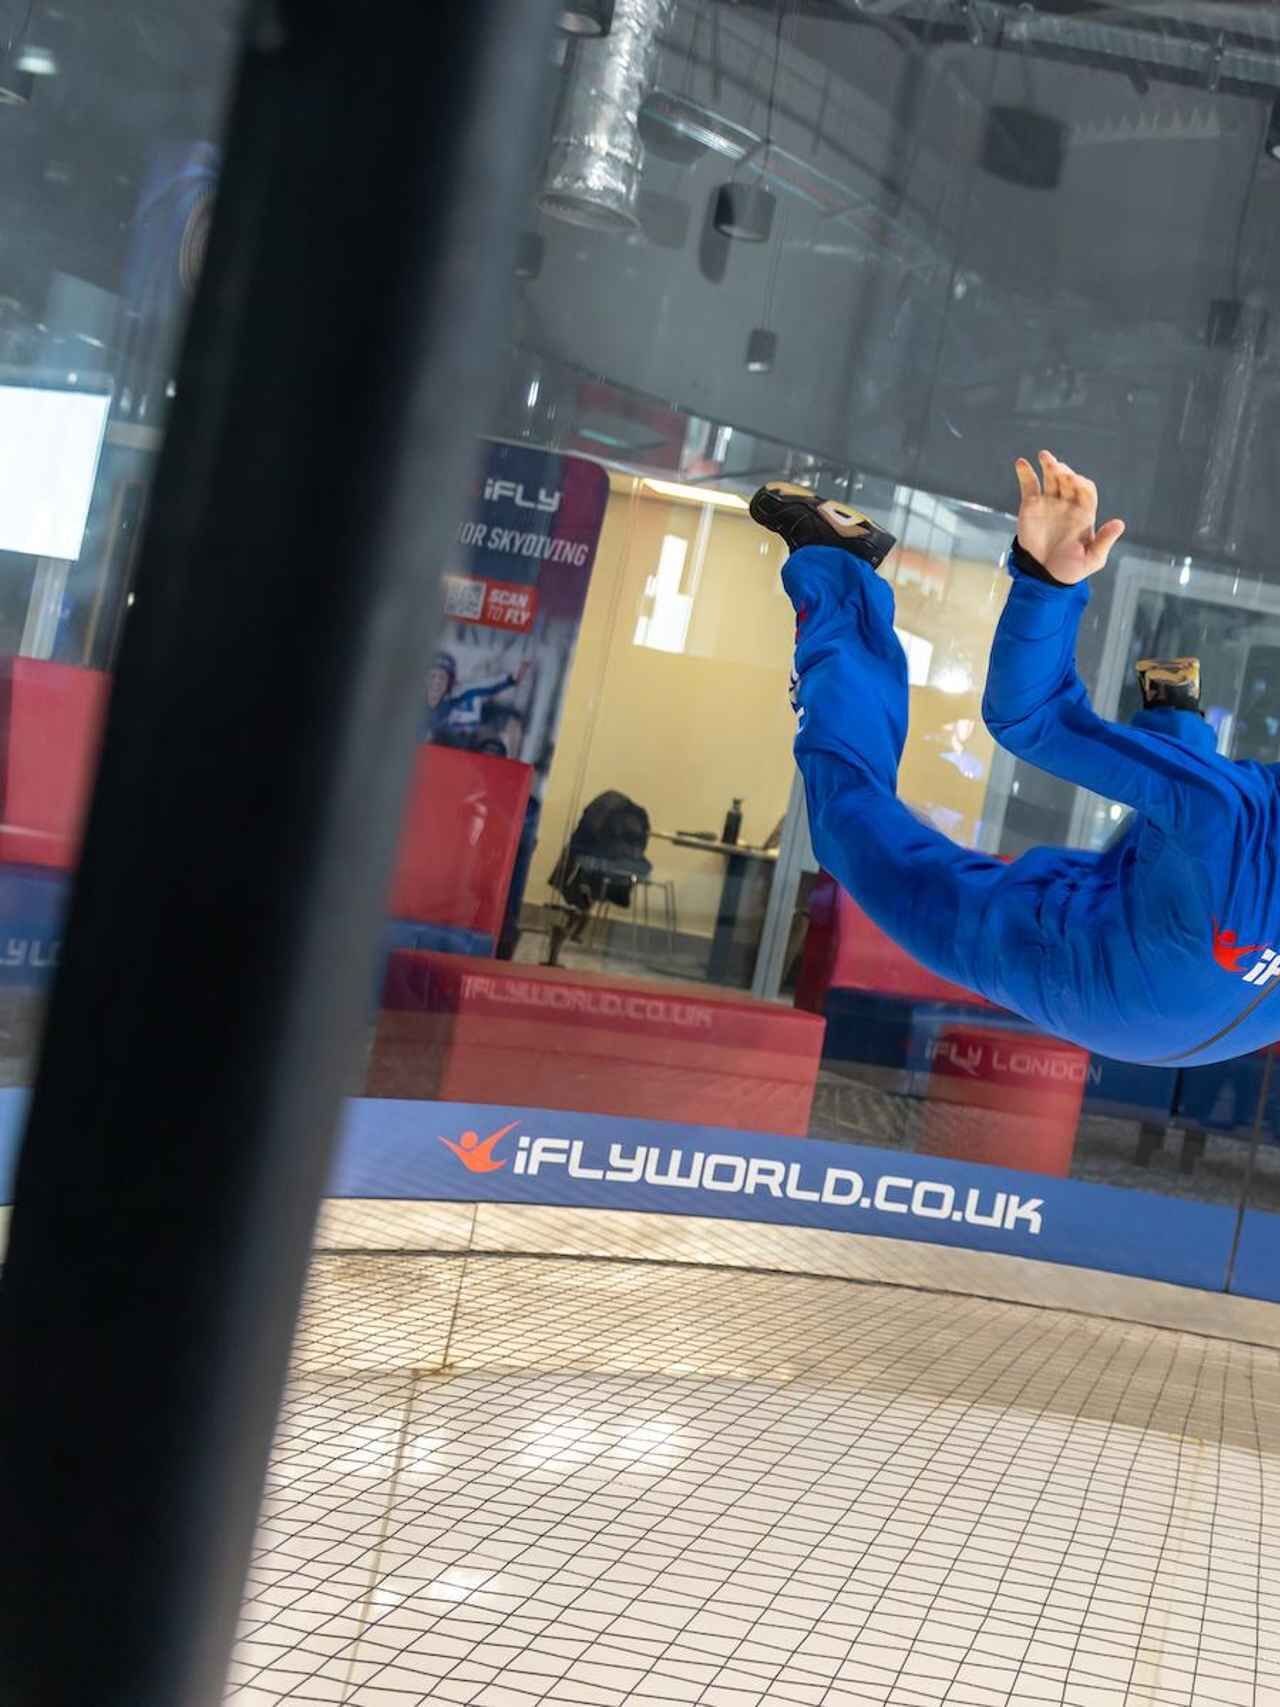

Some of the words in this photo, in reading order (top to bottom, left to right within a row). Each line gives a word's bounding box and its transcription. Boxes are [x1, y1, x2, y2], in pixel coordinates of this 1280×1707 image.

[484, 478, 562, 512] iFLY
[487, 527, 589, 566] SKYDIVING
[486, 602, 504, 620] TO
[503, 606, 531, 625] FLY
[488, 588, 529, 607] SCAN
[991, 1051, 1103, 1085] LONDON
[513, 1136, 1045, 1235] iFLYWORLD.CO.UK
